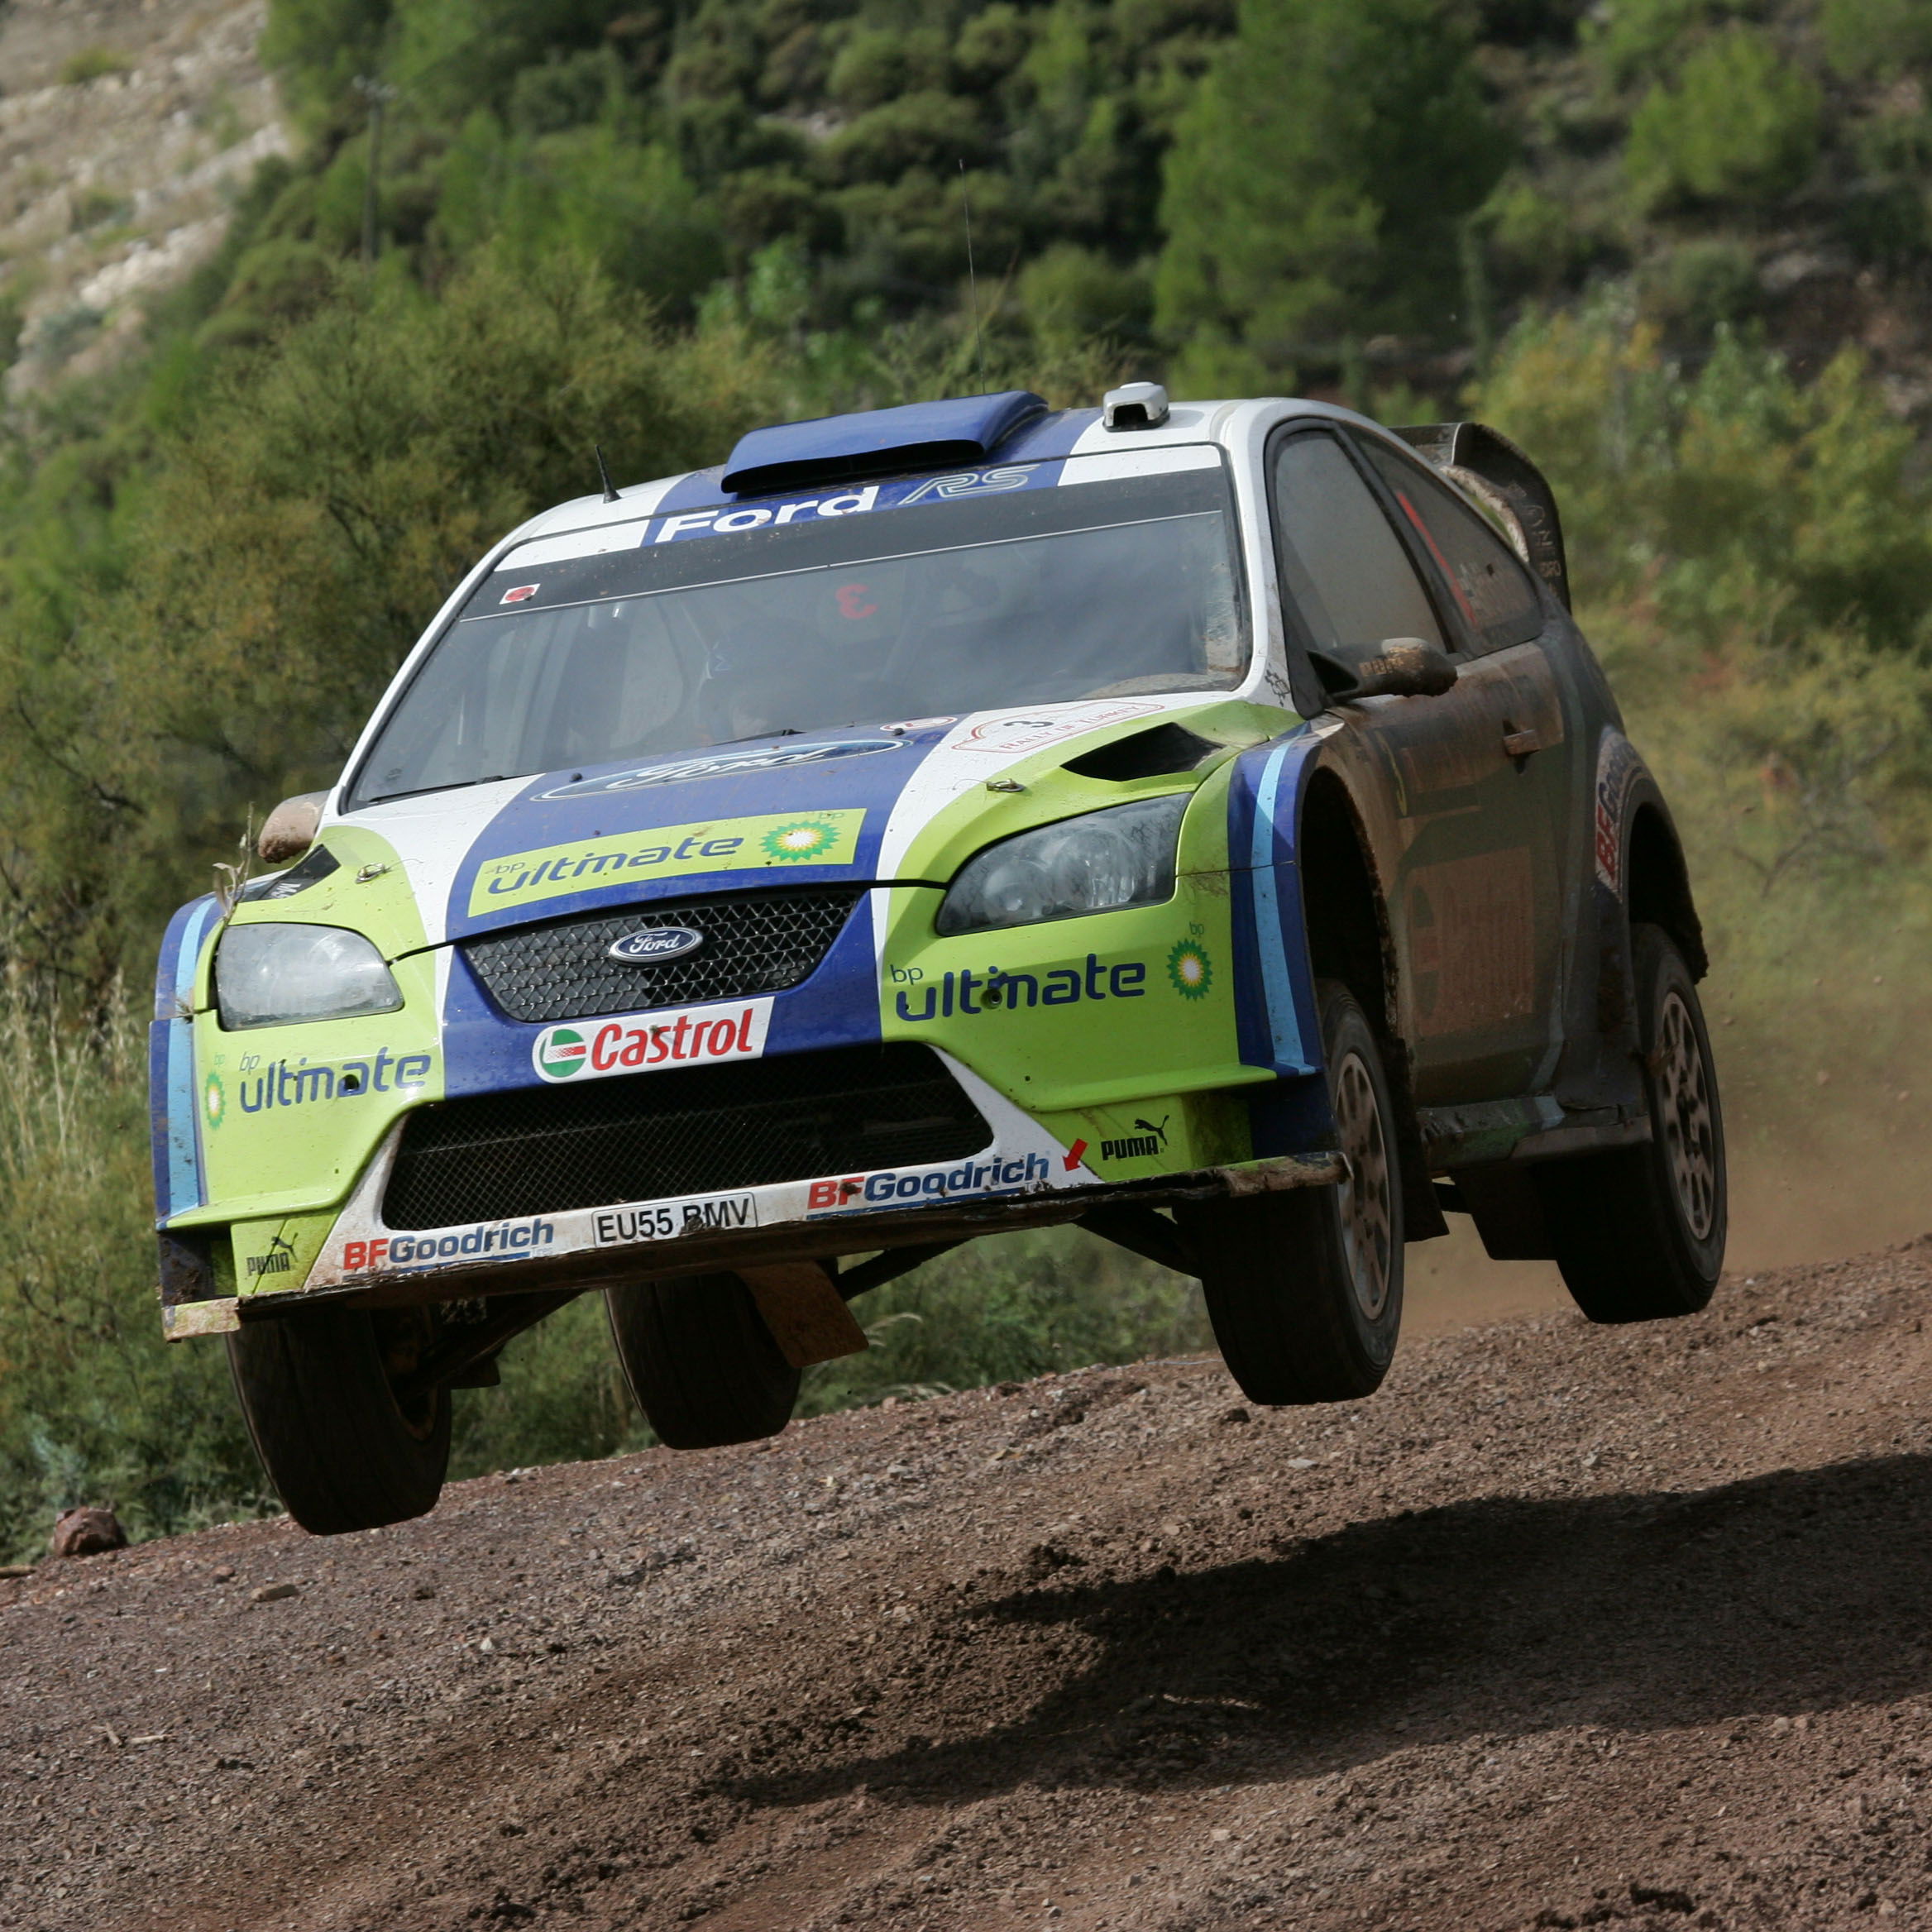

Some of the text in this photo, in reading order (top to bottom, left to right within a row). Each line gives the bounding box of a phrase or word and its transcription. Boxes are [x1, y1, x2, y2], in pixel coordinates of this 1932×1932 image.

[655, 464, 1041, 543] Ford RS
[1002, 720, 1054, 729] 3
[605, 746, 839, 789] Ford
[817, 811, 845, 820] bp
[487, 836, 744, 895] ultimate
[496, 859, 524, 875] bp
[629, 931, 680, 954] Ford
[1189, 921, 1205, 937] bp
[890, 964, 923, 985] bp
[897, 953, 1145, 1021] ultimate
[591, 1008, 753, 1071] Castrol
[239, 1051, 260, 1073] bp
[240, 1046, 431, 1113] ultimate
[1101, 1136, 1159, 1160] PUMA
[807, 1153, 1050, 1210] BFGoodrich
[597, 1208, 673, 1242] EU55
[343, 1218, 553, 1271] BFGoodrich
[246, 1252, 290, 1276] PUMA
